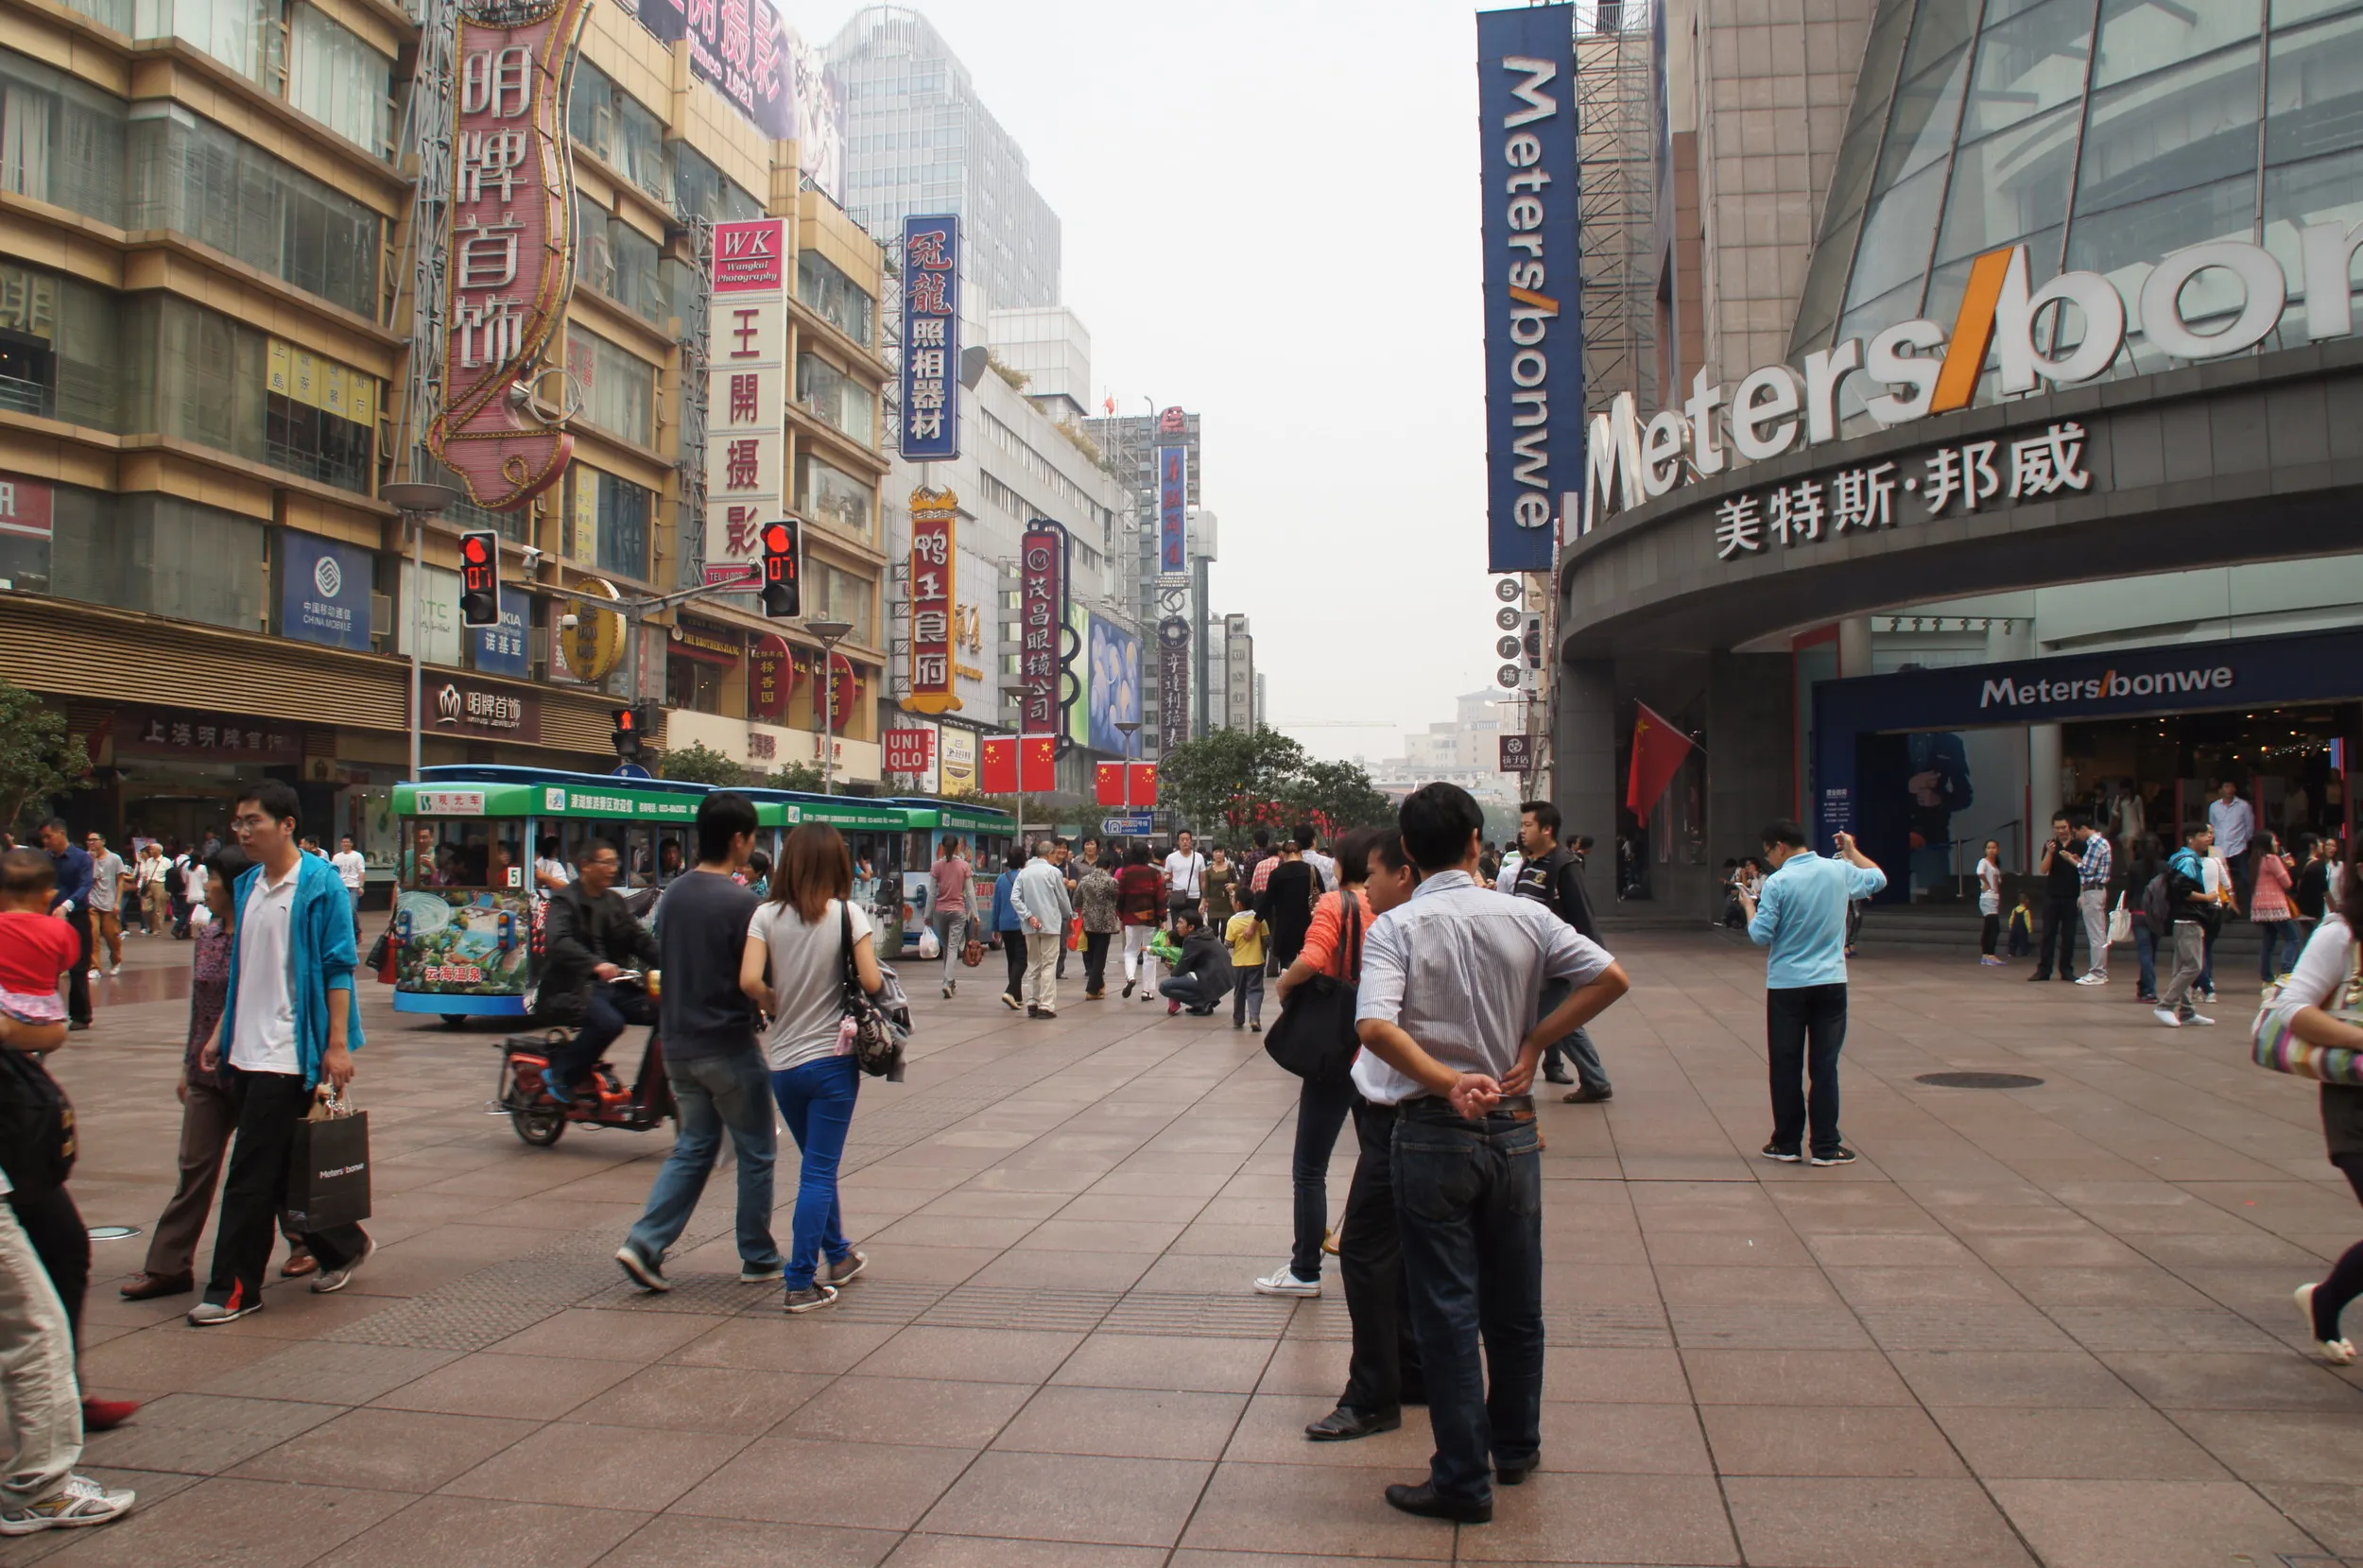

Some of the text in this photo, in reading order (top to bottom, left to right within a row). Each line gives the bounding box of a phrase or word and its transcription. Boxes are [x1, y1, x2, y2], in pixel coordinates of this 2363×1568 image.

[684, 26, 754, 112] Since 1921
[454, 43, 532, 375] 明牌首饰
[717, 272, 777, 283] Photography
[727, 261, 769, 271] Wangkai
[1502, 55, 1560, 529] Meters/bonwe
[1715, 422, 2091, 560] 美特斯·邦威
[468, 567, 492, 590] 07
[768, 556, 794, 580] 07
[914, 529, 947, 685] 鸭王食府
[303, 614, 352, 631] CHINA MOBILE
[485, 632, 522, 656] 诺基亚
[1026, 577, 1053, 721] 茂昌眼镜公司
[1979, 664, 2235, 709] Meters/bonwe
[468, 692, 521, 721] 明牌首饰
[145, 719, 284, 752] 上海明牌首饰
[492, 719, 521, 729] JEWELRY
[889, 734, 919, 750] UNI
[889, 751, 923, 769] QLO
[438, 795, 480, 805] 观光车
[510, 870, 518, 885] 5
[425, 966, 482, 982] 云海温泉
